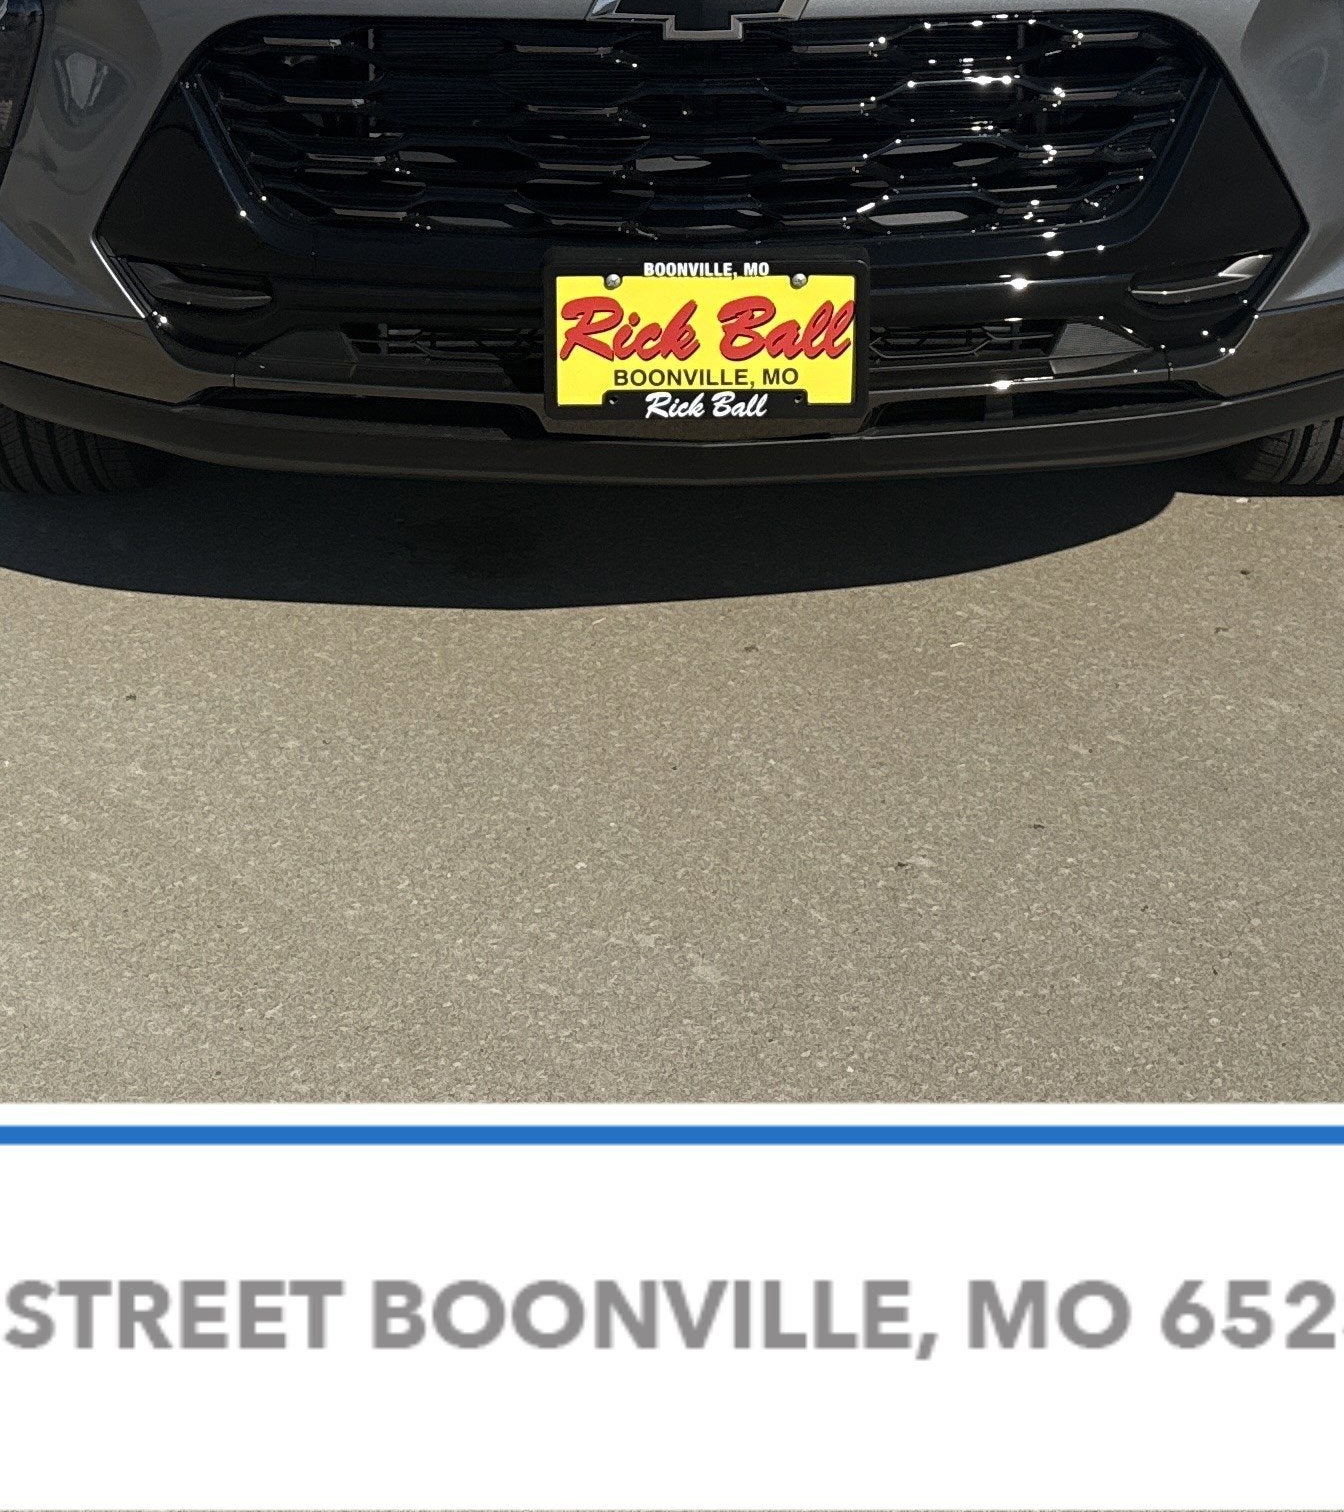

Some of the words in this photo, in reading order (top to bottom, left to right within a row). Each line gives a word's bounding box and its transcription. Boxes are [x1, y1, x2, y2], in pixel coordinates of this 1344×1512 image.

[643, 261, 734, 280] BOONVILLE,
[743, 261, 770, 276] MO
[559, 295, 700, 361] Rick
[718, 295, 855, 361] Ball
[613, 368, 754, 389] BOONVILLE,
[762, 367, 799, 385] MO
[644, 391, 705, 419] Rick
[711, 390, 768, 418] Ball
